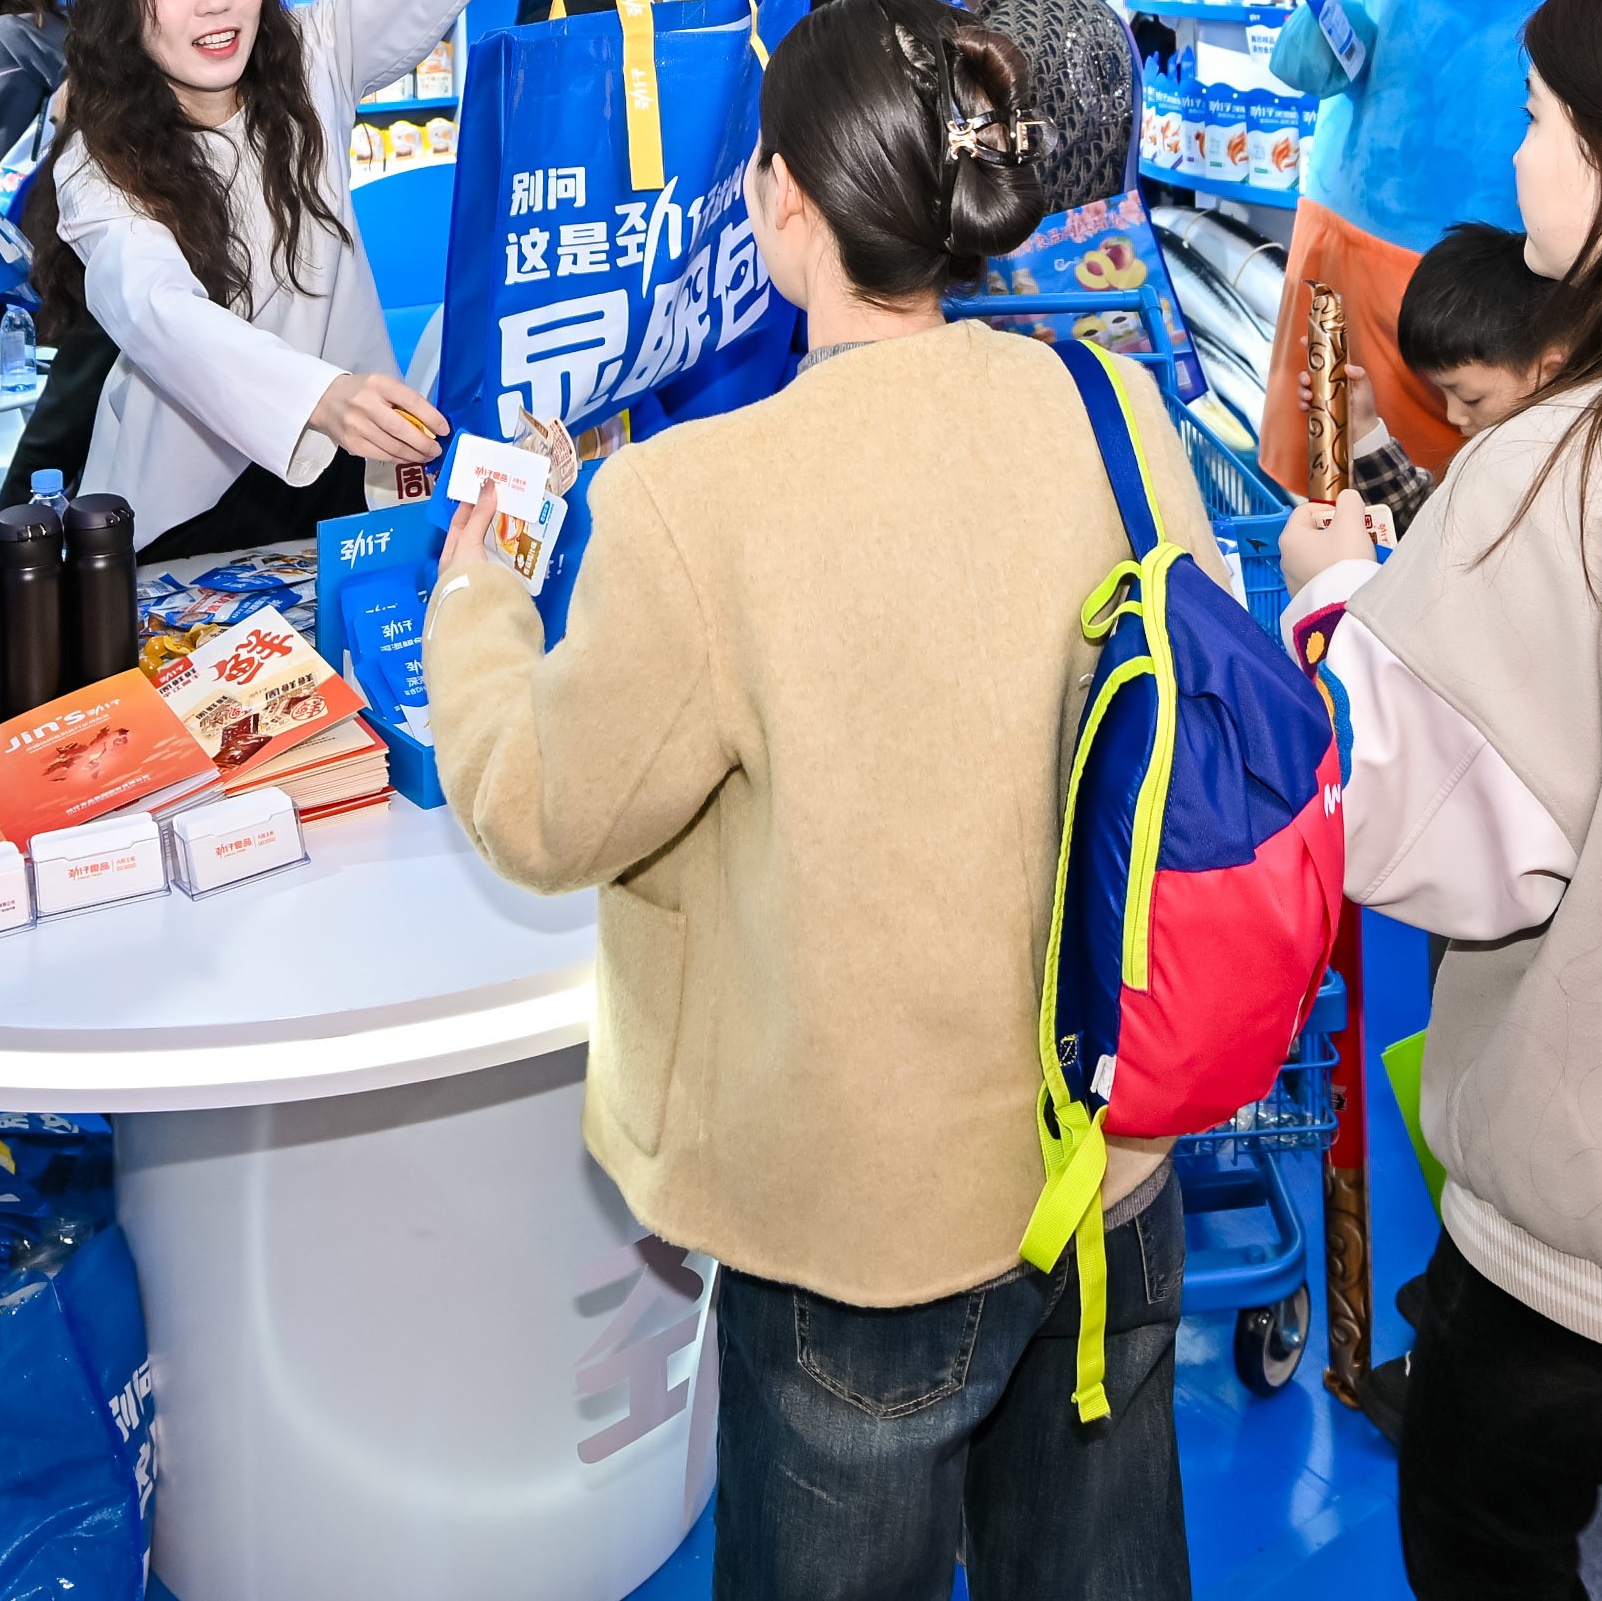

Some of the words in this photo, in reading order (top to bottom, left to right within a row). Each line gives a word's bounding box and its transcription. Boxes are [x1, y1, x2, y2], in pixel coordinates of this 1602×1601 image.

[510, 166, 587, 218] 别问
[340, 529, 391, 570] 劲仔
[380, 619, 413, 642] 劲仔
[207, 629, 295, 686] 鲜
